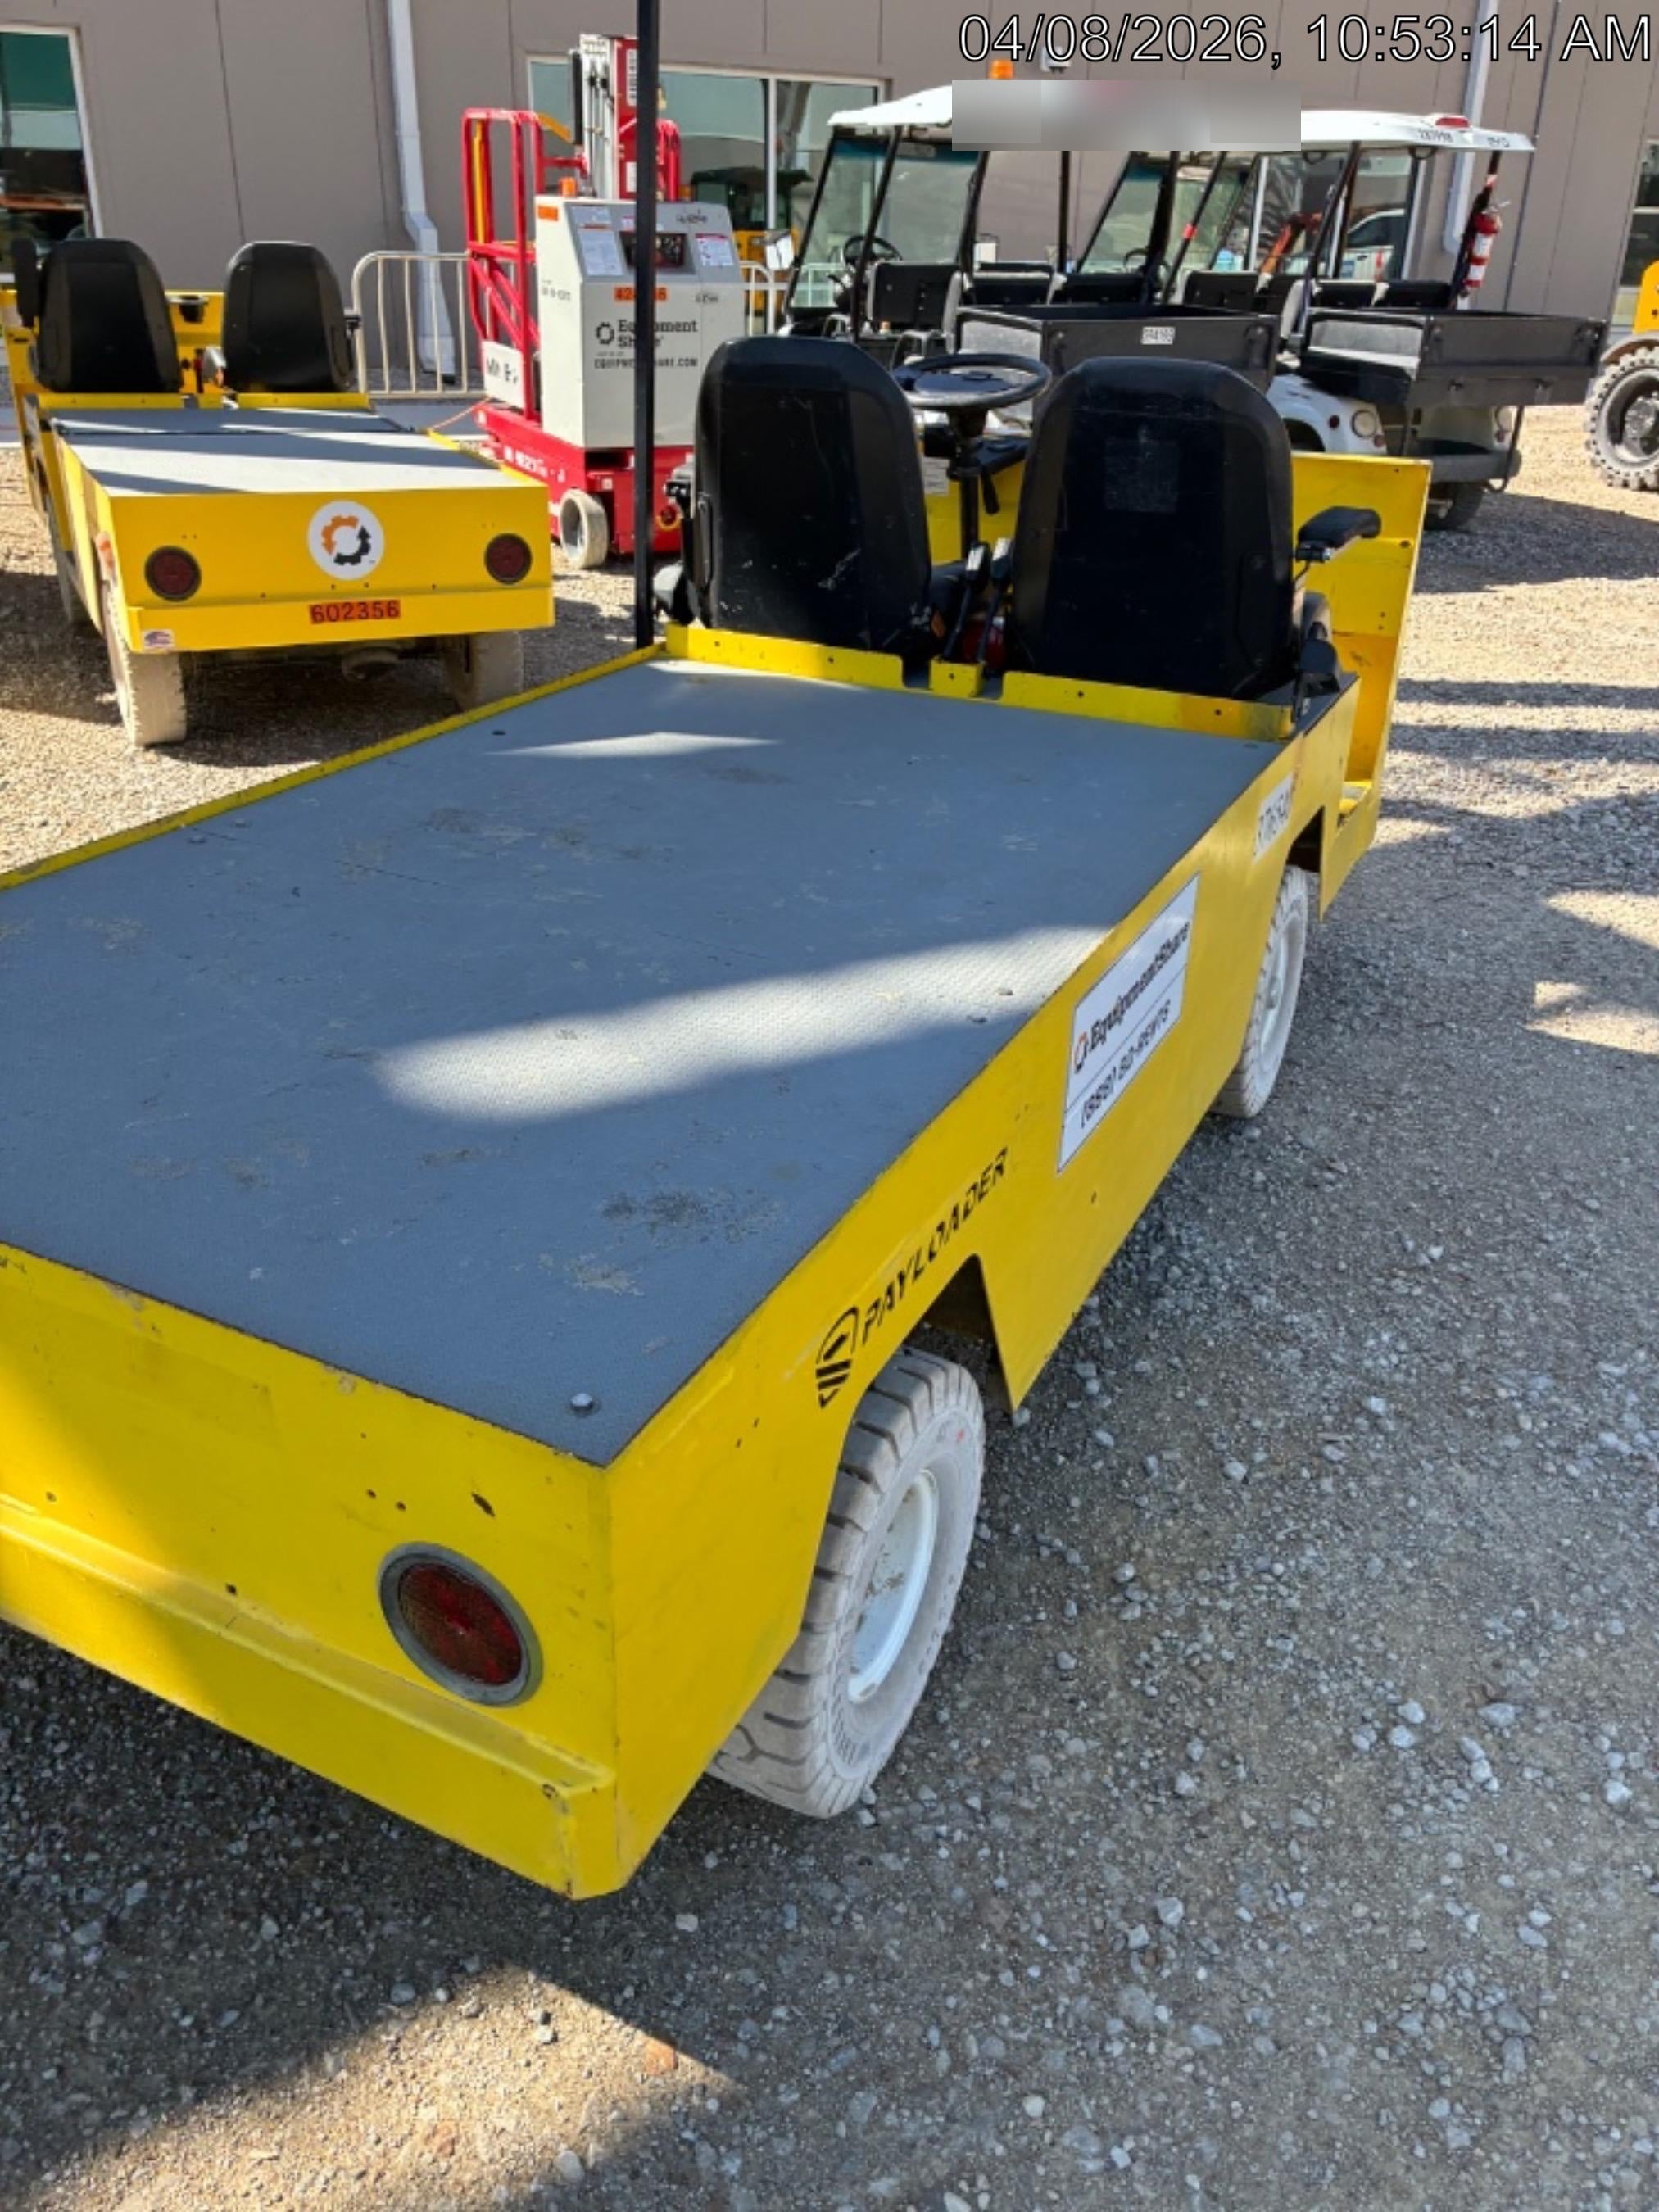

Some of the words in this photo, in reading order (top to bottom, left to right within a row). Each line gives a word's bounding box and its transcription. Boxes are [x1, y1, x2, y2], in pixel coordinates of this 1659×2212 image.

[310, 600, 401, 624] 602356
[1089, 921, 1191, 1054] EquipmentShare
[863, 1146, 1009, 1345] PAYLOADER
